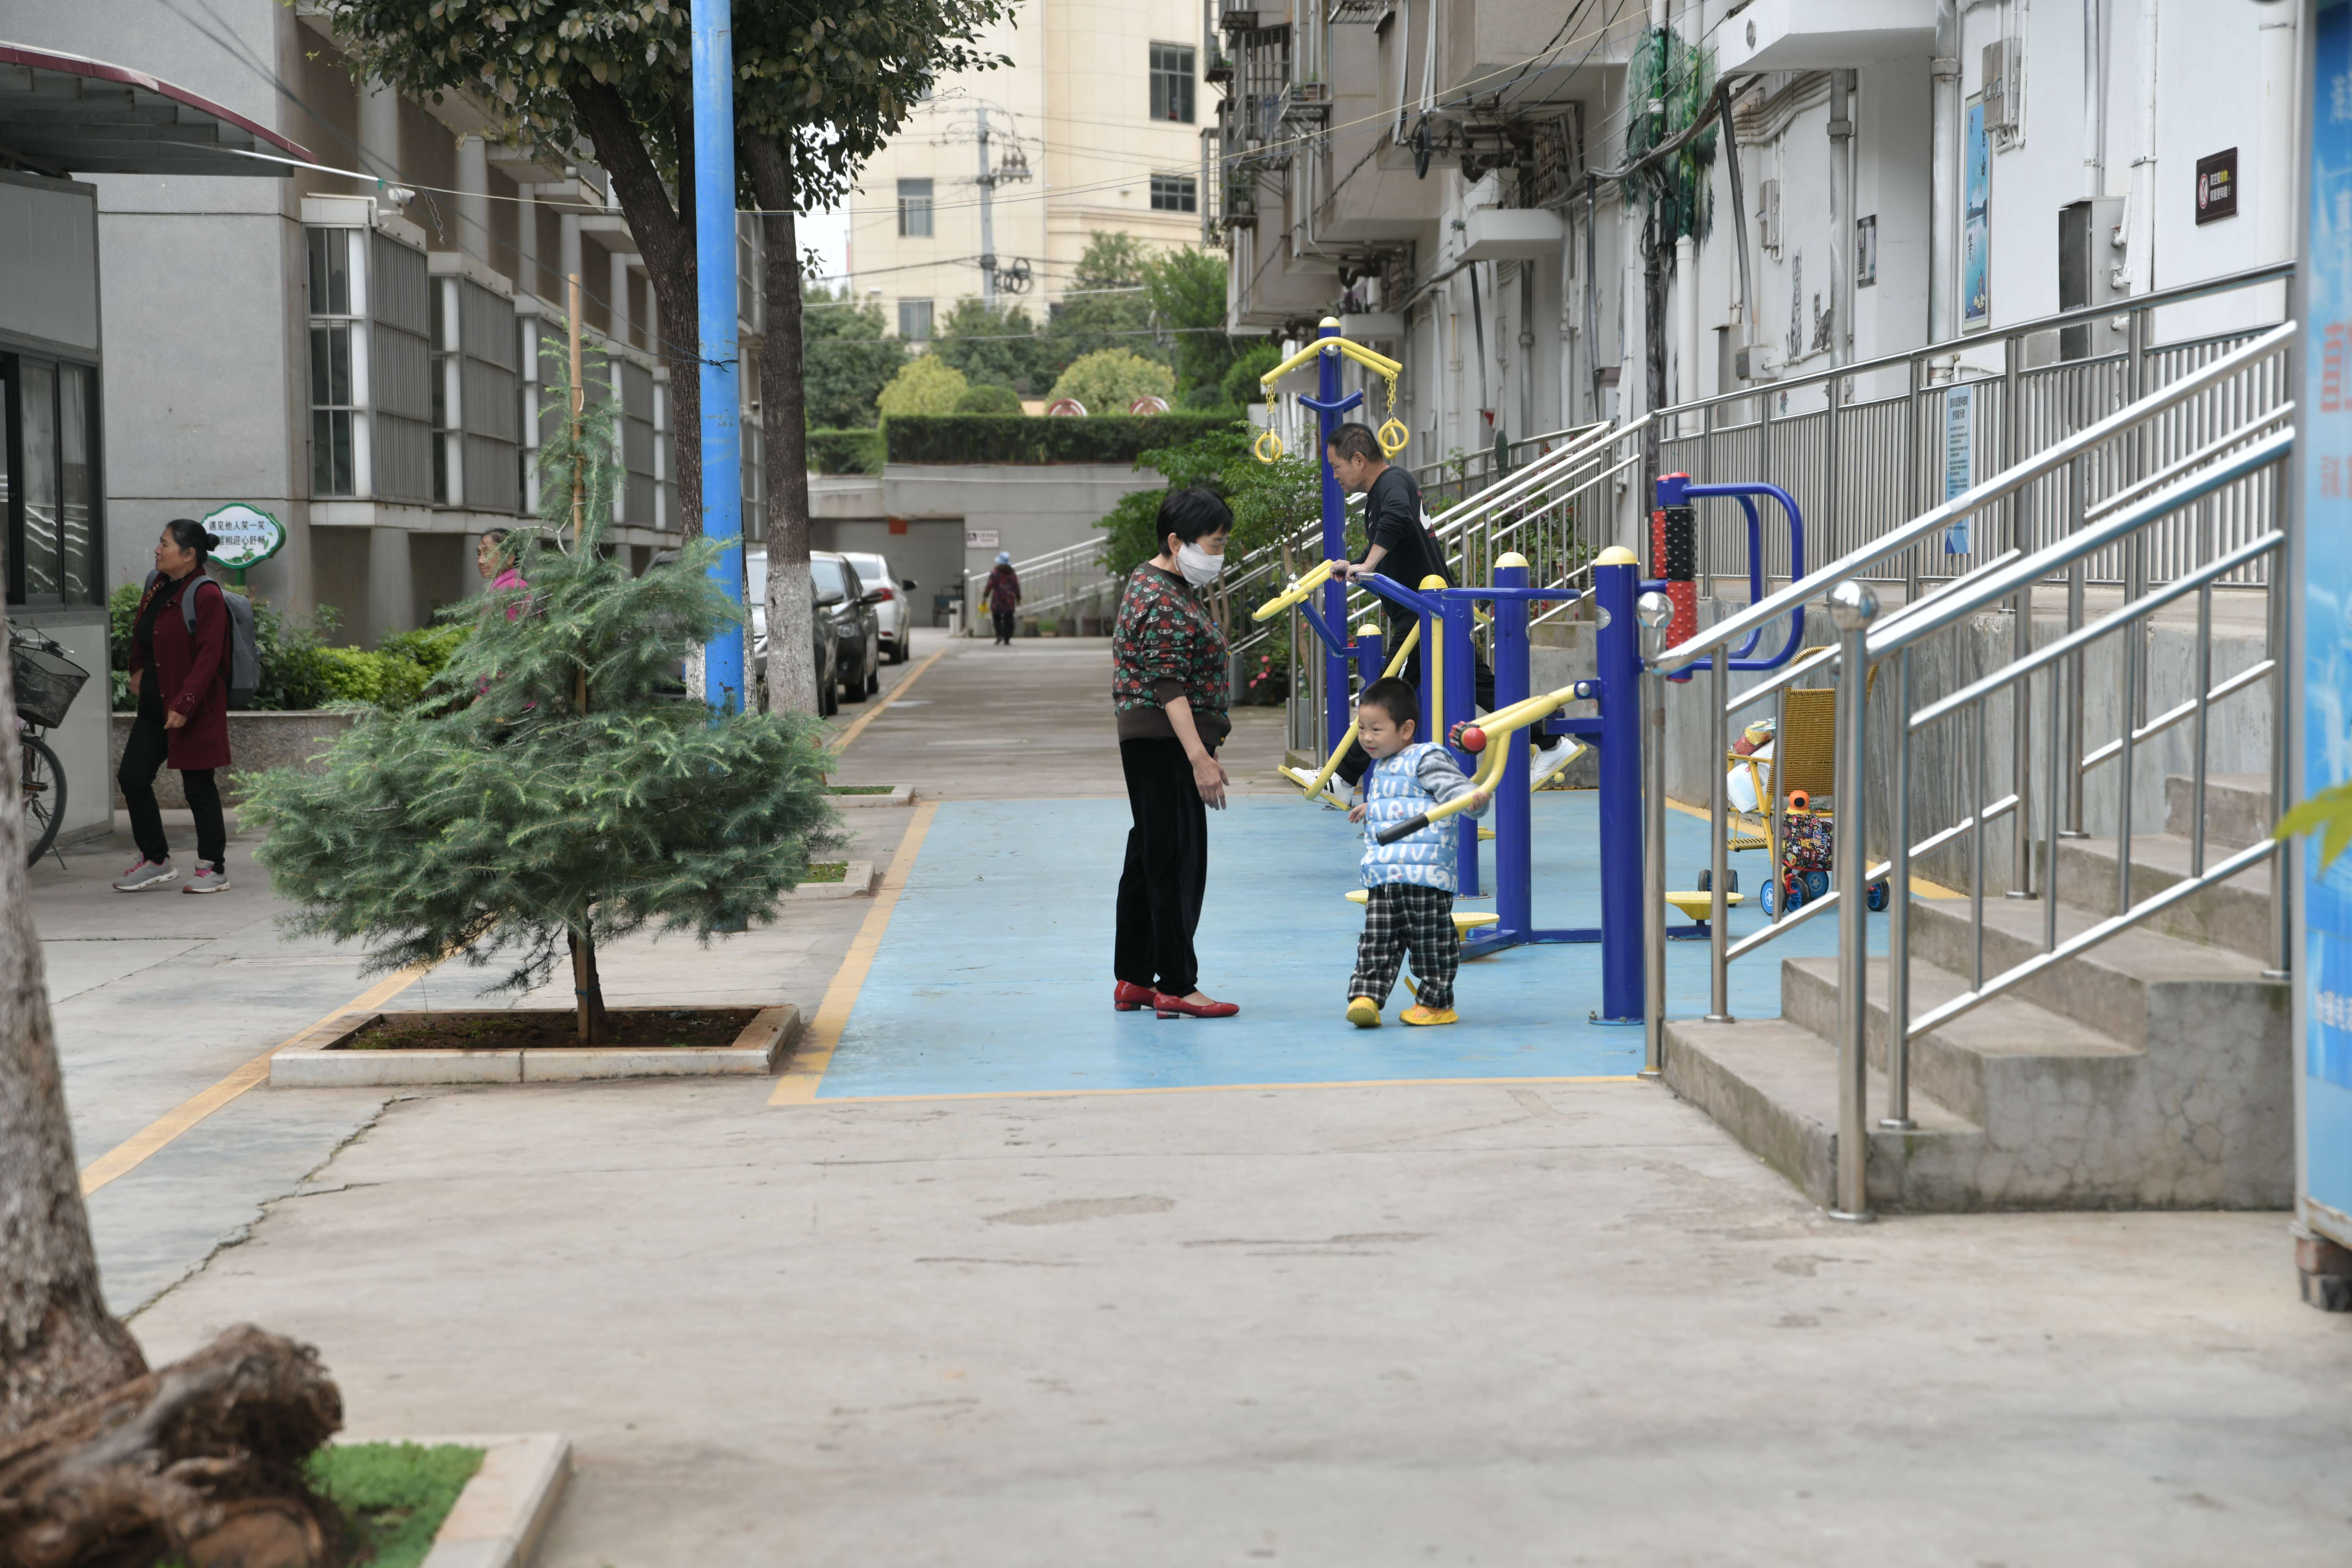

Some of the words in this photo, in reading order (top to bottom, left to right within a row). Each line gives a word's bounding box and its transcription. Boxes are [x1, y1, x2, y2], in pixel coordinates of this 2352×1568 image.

[209, 521, 265, 531] 遇见他人笑一笑
[218, 535, 266, 545] 脸相迎心舒畅
